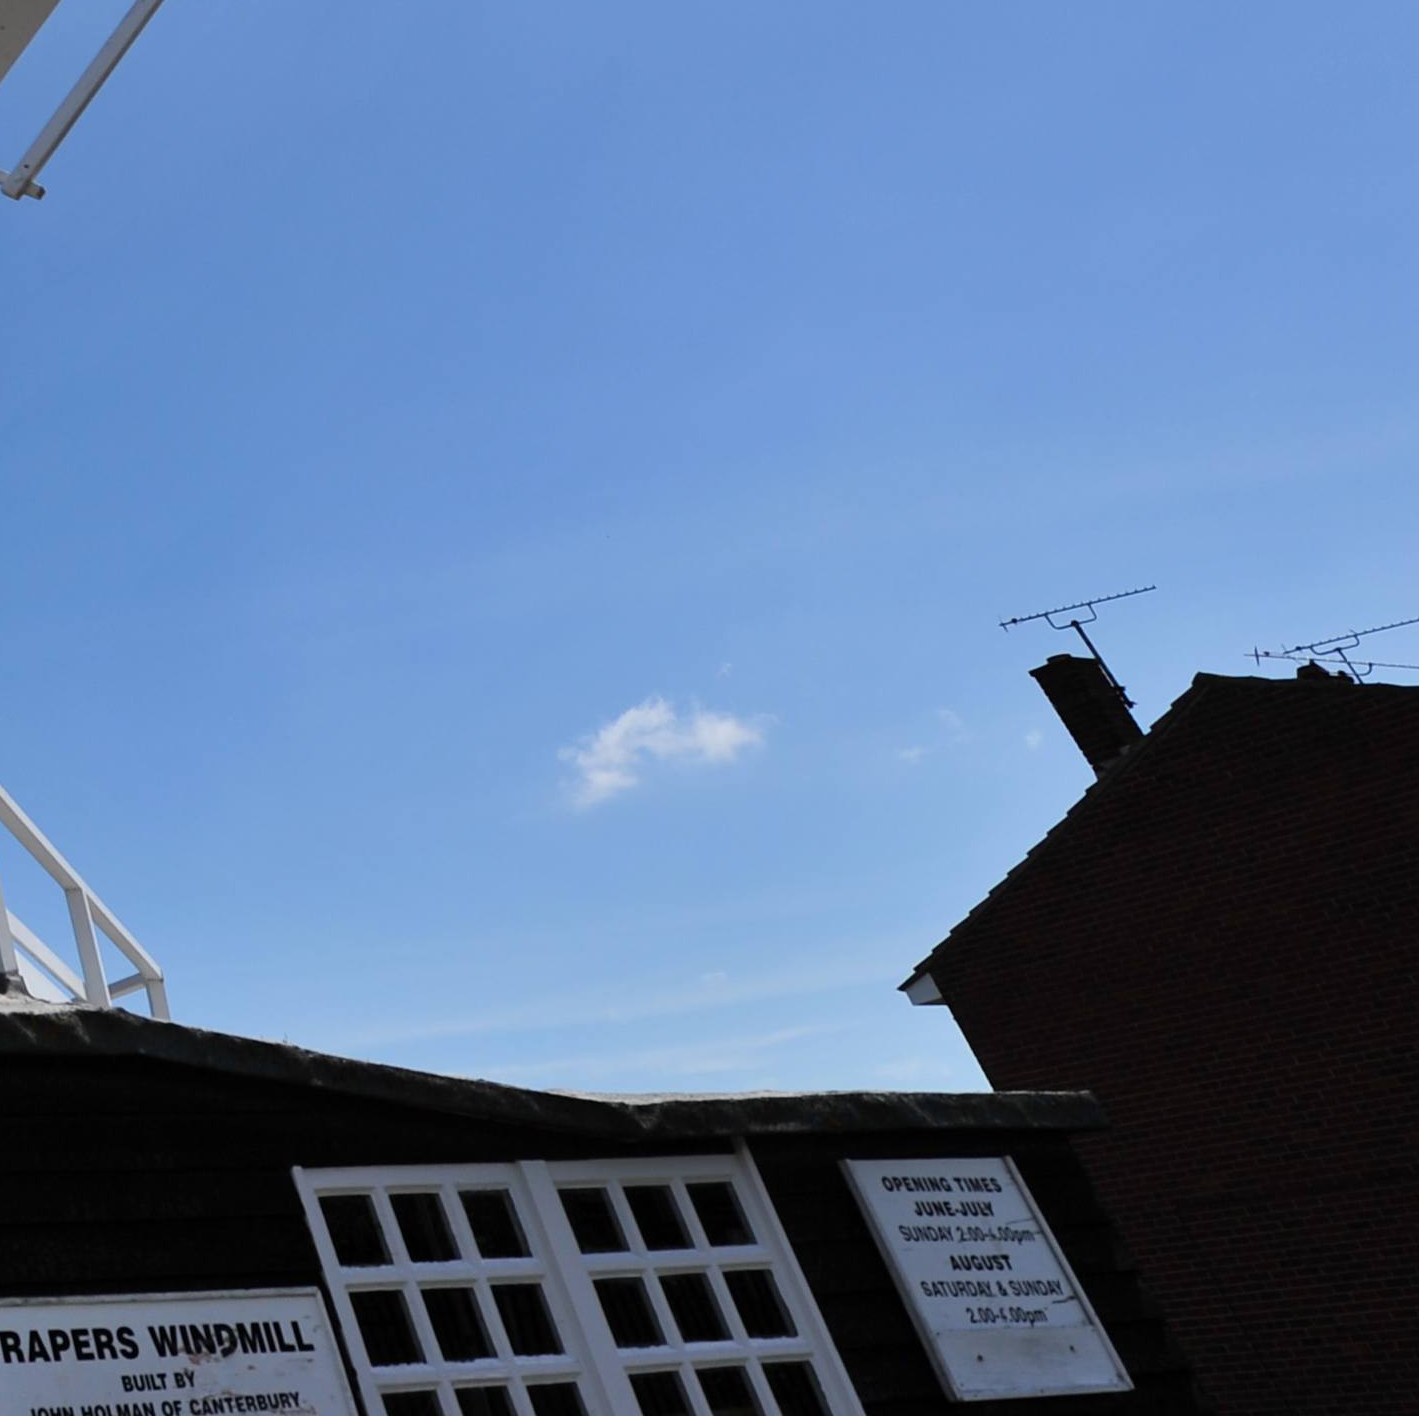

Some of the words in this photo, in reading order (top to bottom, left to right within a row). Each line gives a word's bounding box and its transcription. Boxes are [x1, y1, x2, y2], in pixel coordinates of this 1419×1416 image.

[881, 1176, 952, 1192] OPENING
[954, 1177, 1002, 1193] TIMES
[914, 1201, 995, 1217] JUNE-JULY
[898, 1225, 954, 1242] SUNDAY
[949, 1254, 1013, 1271] AUGUST
[920, 1280, 993, 1297] SATURDAY
[996, 1280, 1008, 1297] &
[1008, 1280, 1064, 1297] SUNDAY
[147, 1321, 315, 1358] WINDMILL
[121, 1372, 167, 1392] BUILT
[174, 1370, 195, 1388] BY
[81, 1402, 156, 1416] HOLMAN
[161, 1400, 182, 1416] OF
[189, 1392, 300, 1416] CANTERBURY
